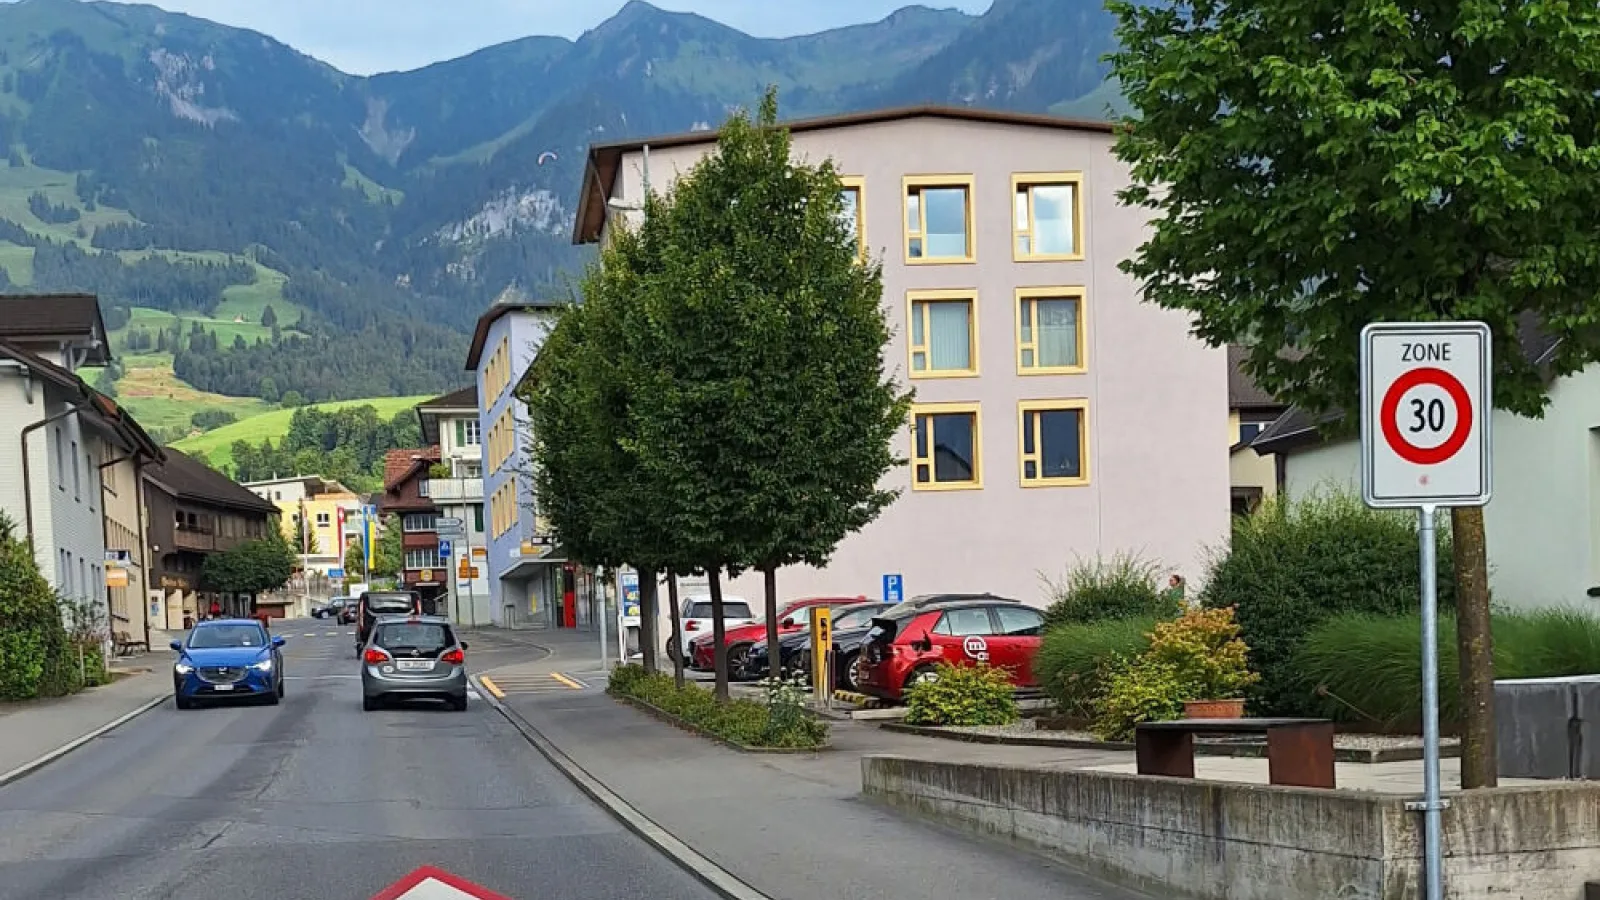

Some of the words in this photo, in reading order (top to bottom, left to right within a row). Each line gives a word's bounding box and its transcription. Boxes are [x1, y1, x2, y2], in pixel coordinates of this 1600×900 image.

[1401, 343, 1451, 361] ZONE
[1409, 398, 1445, 432] 30
[888, 575, 897, 592] P
